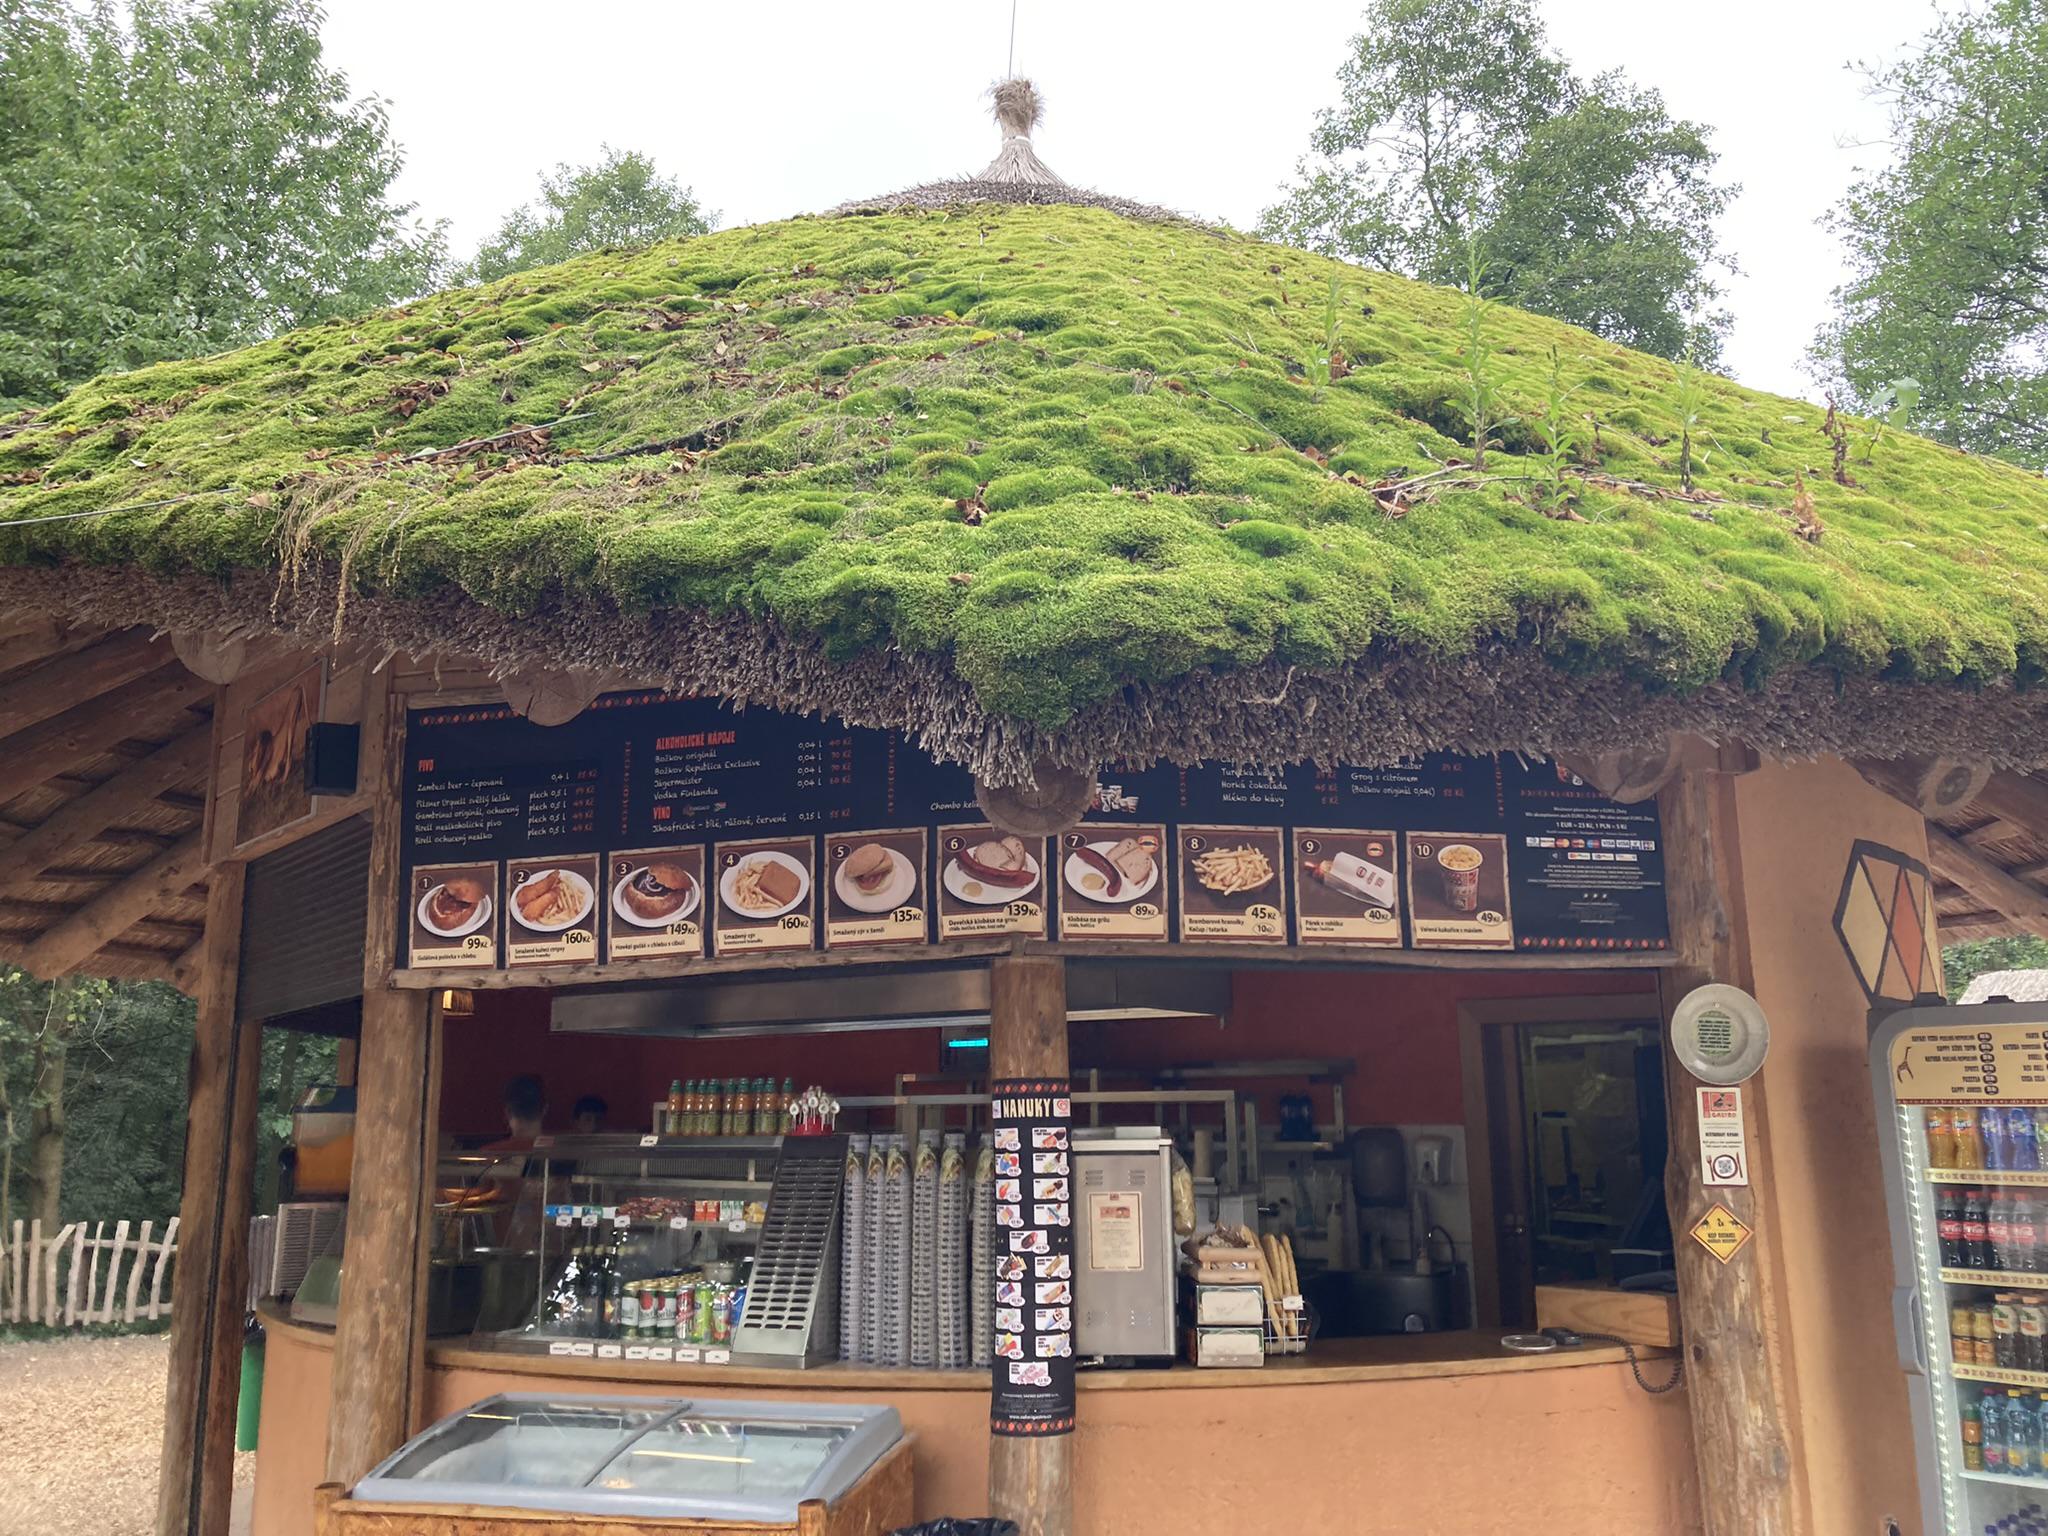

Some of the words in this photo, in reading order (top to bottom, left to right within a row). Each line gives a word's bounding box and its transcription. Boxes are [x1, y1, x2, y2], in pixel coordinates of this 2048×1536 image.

[707, 730, 736, 745] NÁPOJE
[418, 759, 435, 772] PIVO
[530, 790, 548, 804] plech
[529, 802, 548, 816] plech
[652, 805, 672, 820] VÍNO
[528, 814, 547, 829] plech
[527, 827, 546, 840] plech
[951, 838, 958, 849] 6
[1071, 836, 1078, 846] 7
[1191, 838, 1199, 849] 8
[1306, 841, 1313, 852] 9
[837, 847, 845, 857] 5
[1416, 845, 1430, 856] 10
[726, 855, 734, 865] 4
[620, 864, 627, 874] 3
[518, 872, 525, 882] 2
[423, 878, 428, 888] 1
[1002, 1098, 1050, 1118] NANUKY
